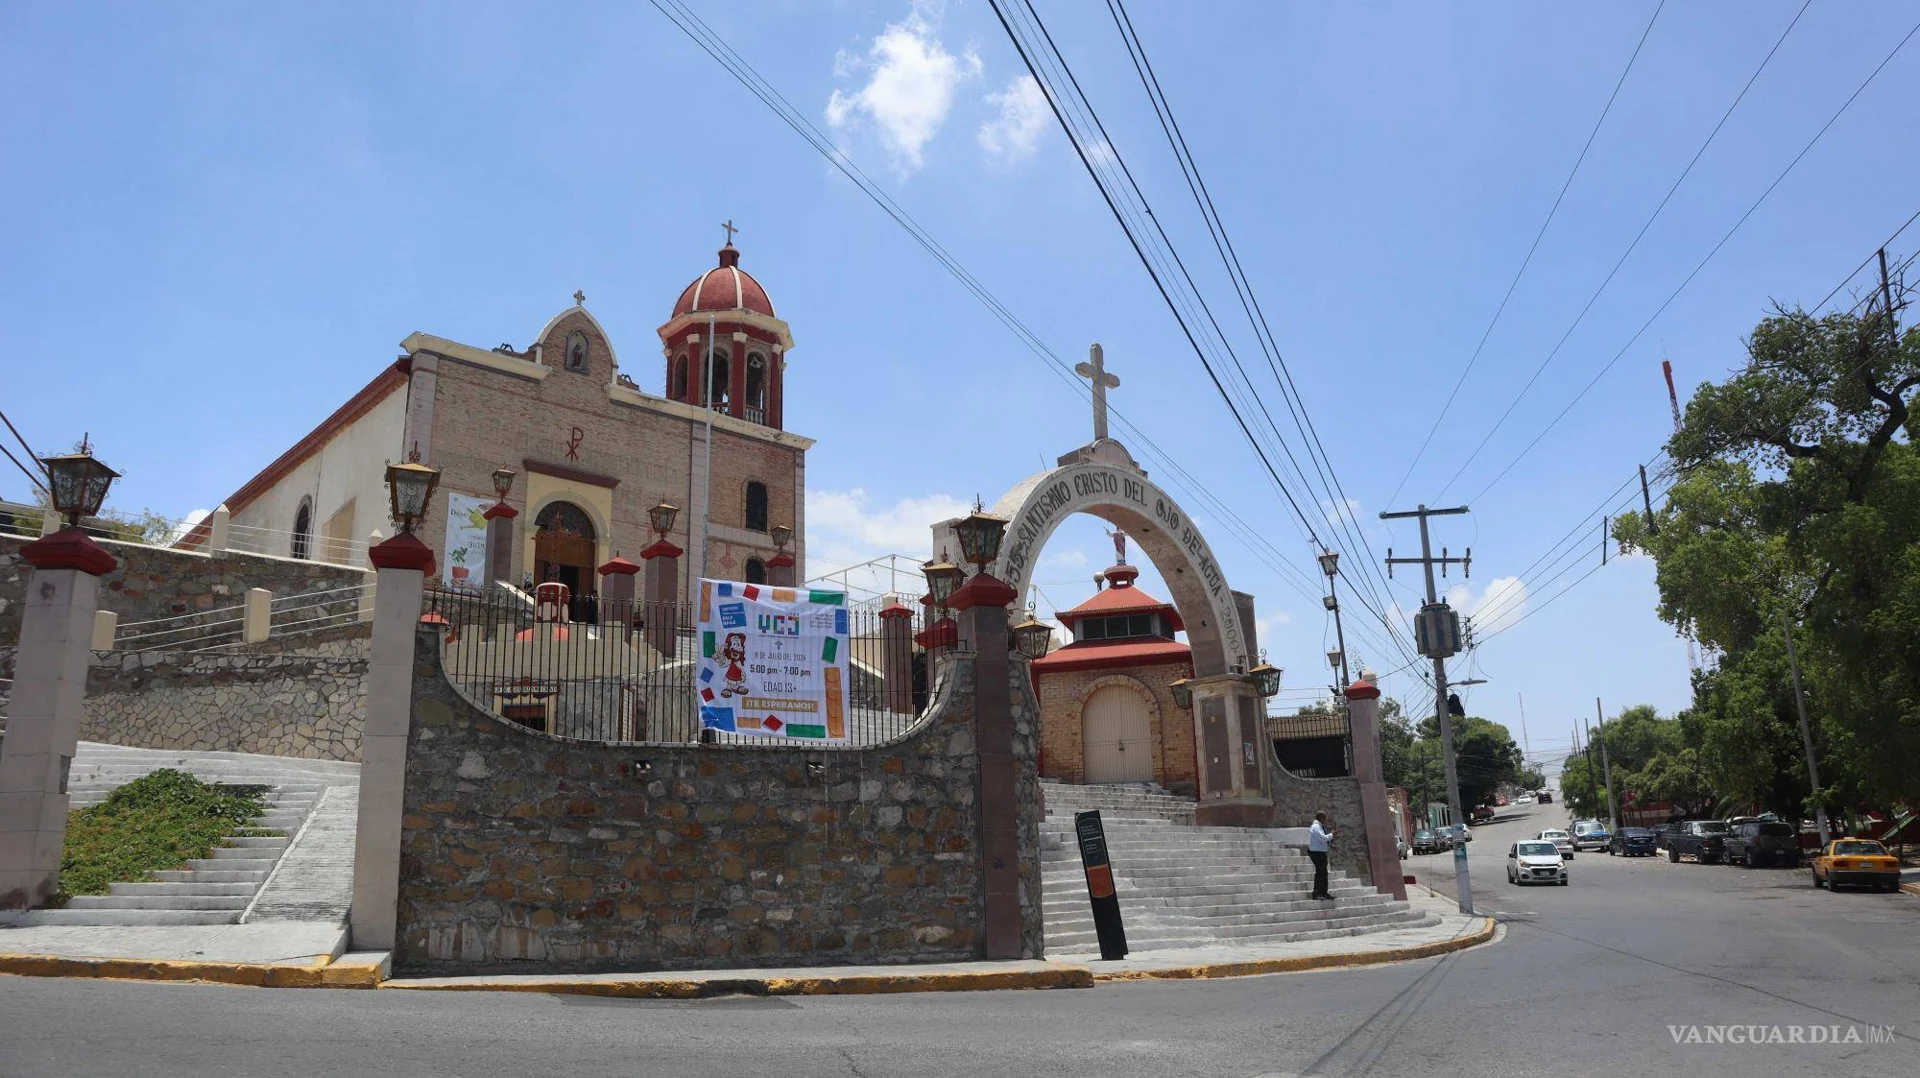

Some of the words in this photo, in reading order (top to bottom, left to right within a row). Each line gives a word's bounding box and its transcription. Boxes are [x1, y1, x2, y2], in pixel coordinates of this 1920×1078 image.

[1017, 481, 1071, 546] SANTISIMO
[1074, 472, 1118, 496] CRISTO
[1123, 477, 1148, 507] DEL
[1156, 498, 1179, 530] OJO
[1199, 555, 1222, 597] AGUA
[766, 667, 778, 676] pm
[783, 665, 799, 676] 7:00
[800, 669, 811, 677] pm
[763, 681, 783, 693] EDAD
[761, 700, 815, 710] ESPERAMOS!
